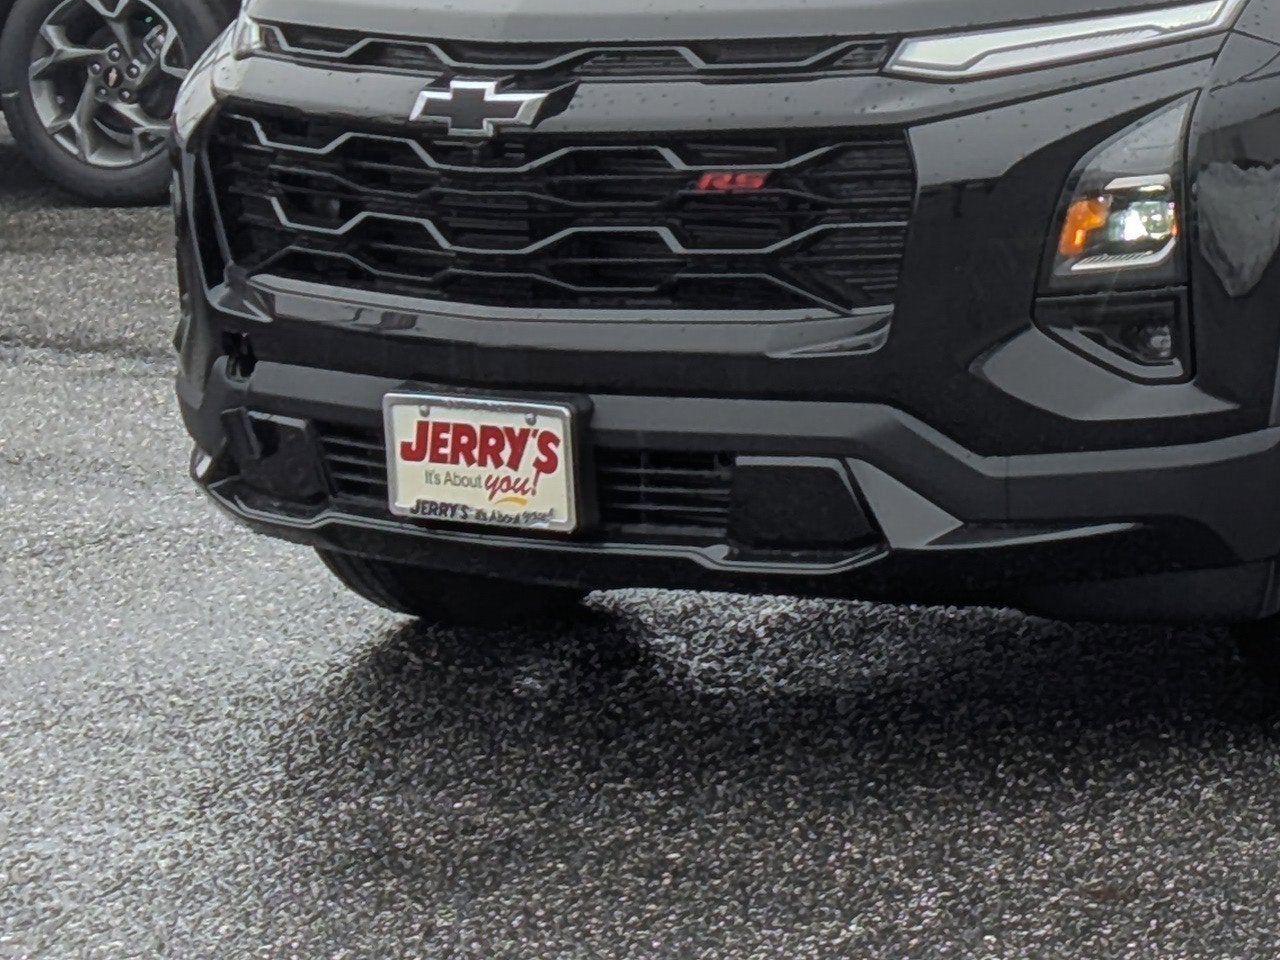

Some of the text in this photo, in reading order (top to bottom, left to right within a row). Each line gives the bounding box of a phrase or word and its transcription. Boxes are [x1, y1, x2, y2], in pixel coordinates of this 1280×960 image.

[400, 420, 561, 474] JERRY'S
[424, 467, 541, 501] It's About you!
